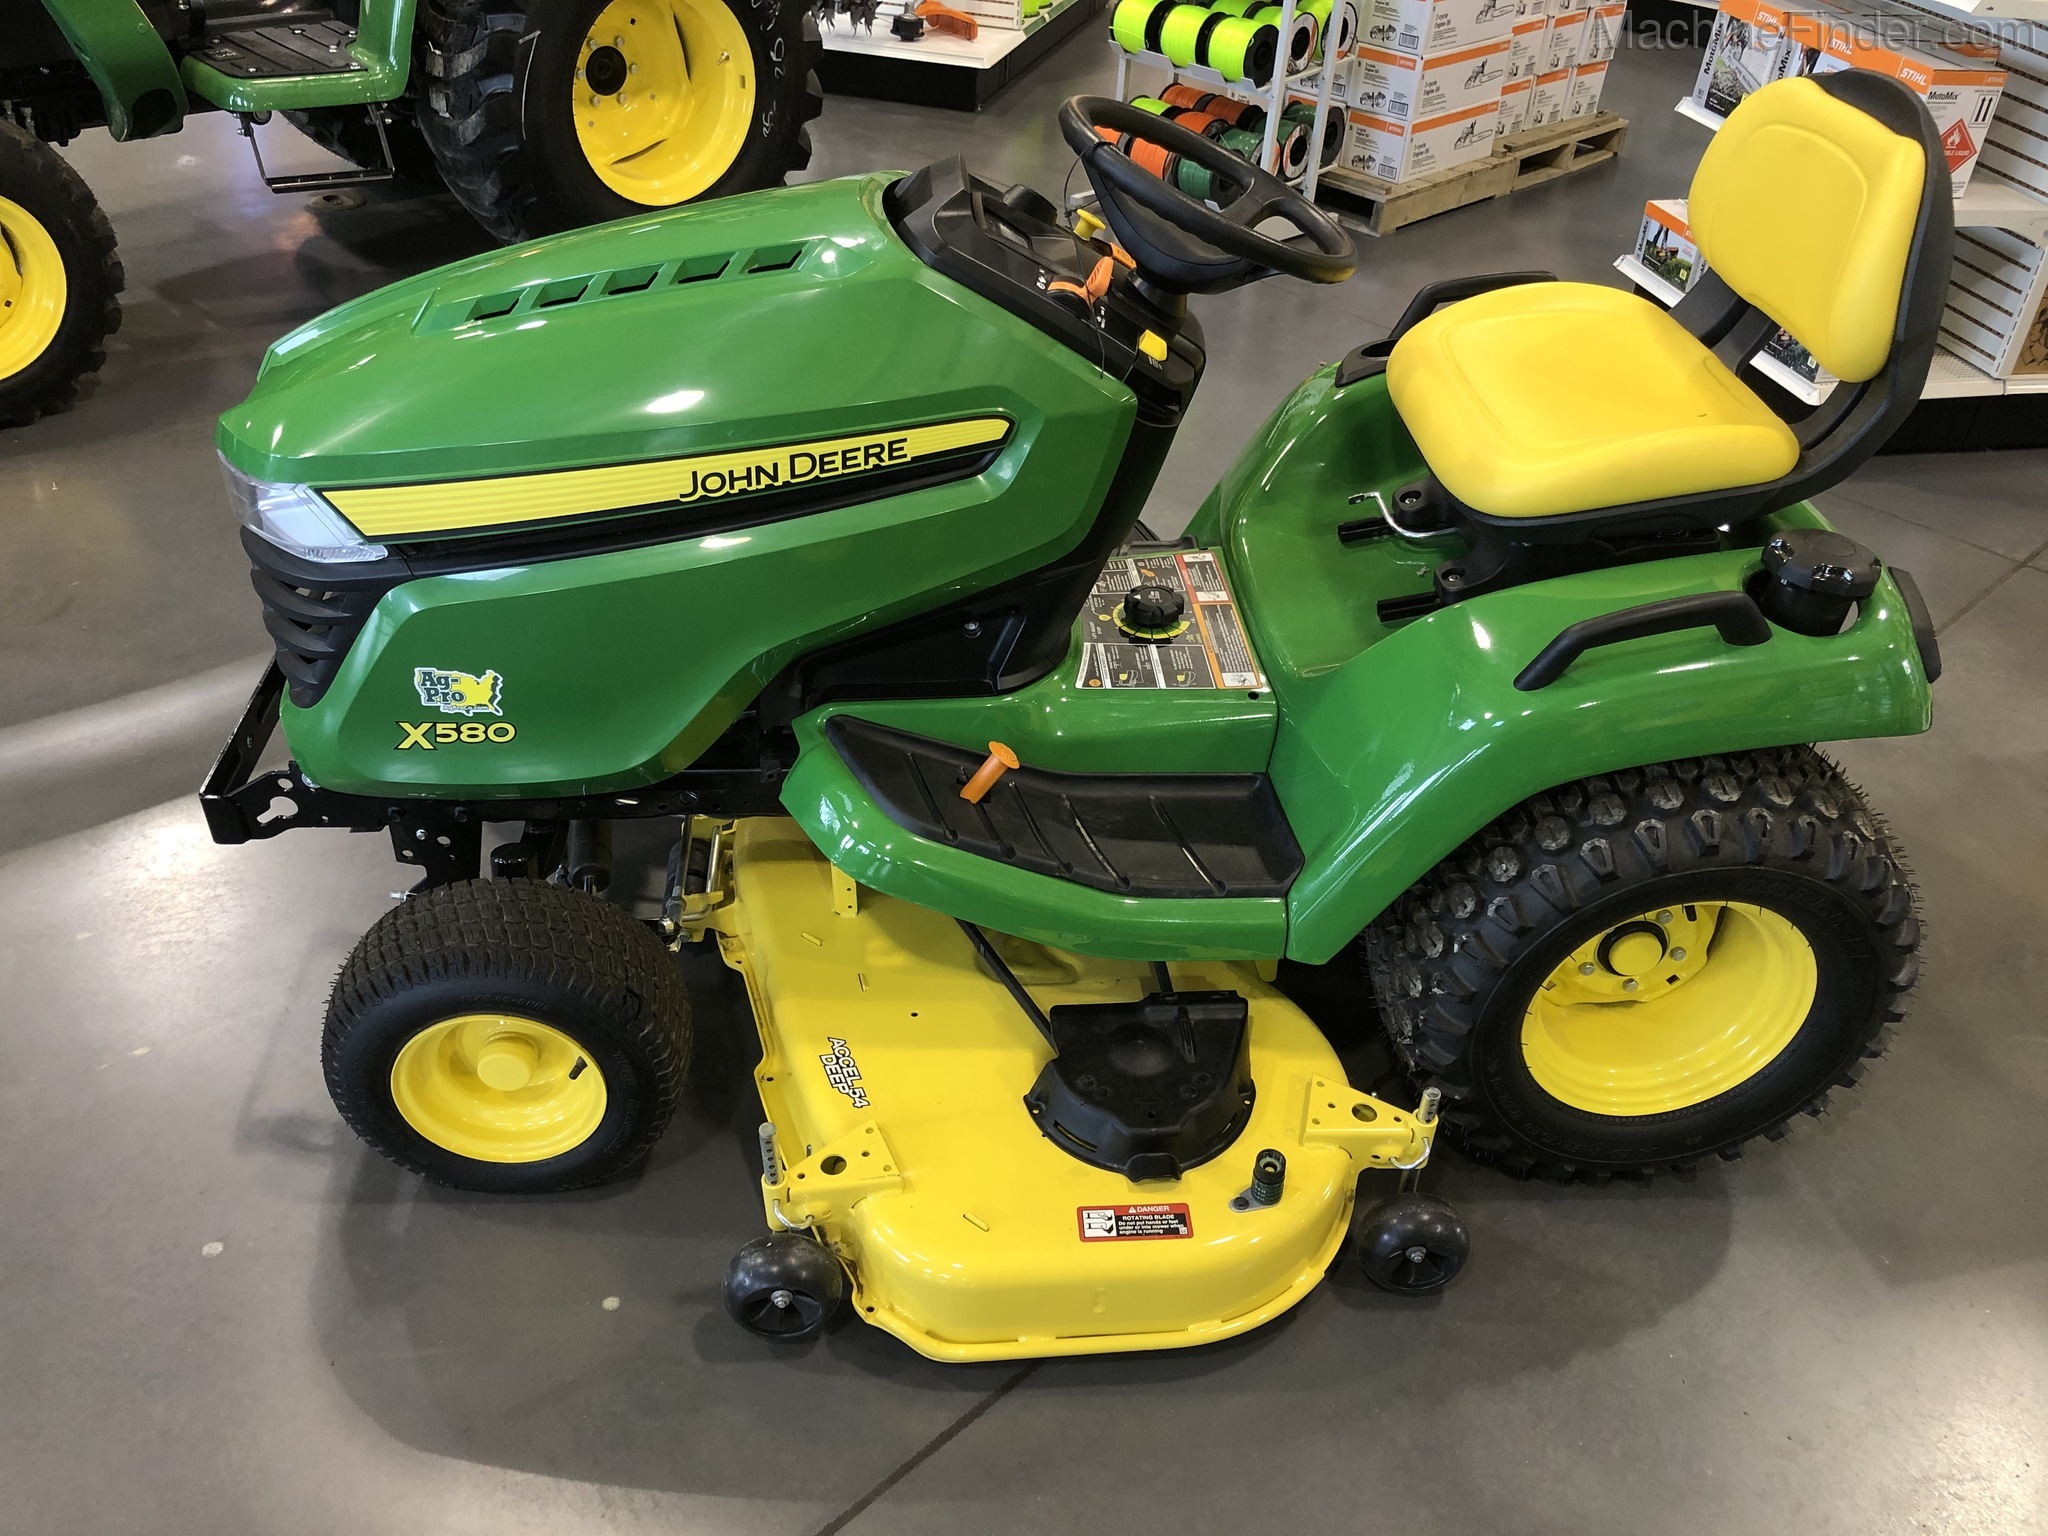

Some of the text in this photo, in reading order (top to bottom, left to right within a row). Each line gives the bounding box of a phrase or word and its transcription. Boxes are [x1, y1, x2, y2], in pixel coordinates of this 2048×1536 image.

[1434, 20, 1446, 29] Engine
[1756, 11, 1780, 25] STIHL
[1704, 22, 1724, 75] MotoMix
[1830, 38, 1853, 55] STIHL
[1900, 67, 1929, 86] STIHL
[1423, 88, 1434, 96] Engine
[1928, 90, 1960, 100] MotoMix
[1412, 150, 1424, 158] Engine
[1638, 221, 1649, 252] MotoMix
[679, 437, 908, 500] JOHN DEERE
[420, 671, 459, 690] Ag-
[426, 688, 465, 704] Pro
[394, 721, 517, 751] X580
[819, 1053, 849, 1094] DEEP
[827, 1037, 870, 1108] ACCEL 54
